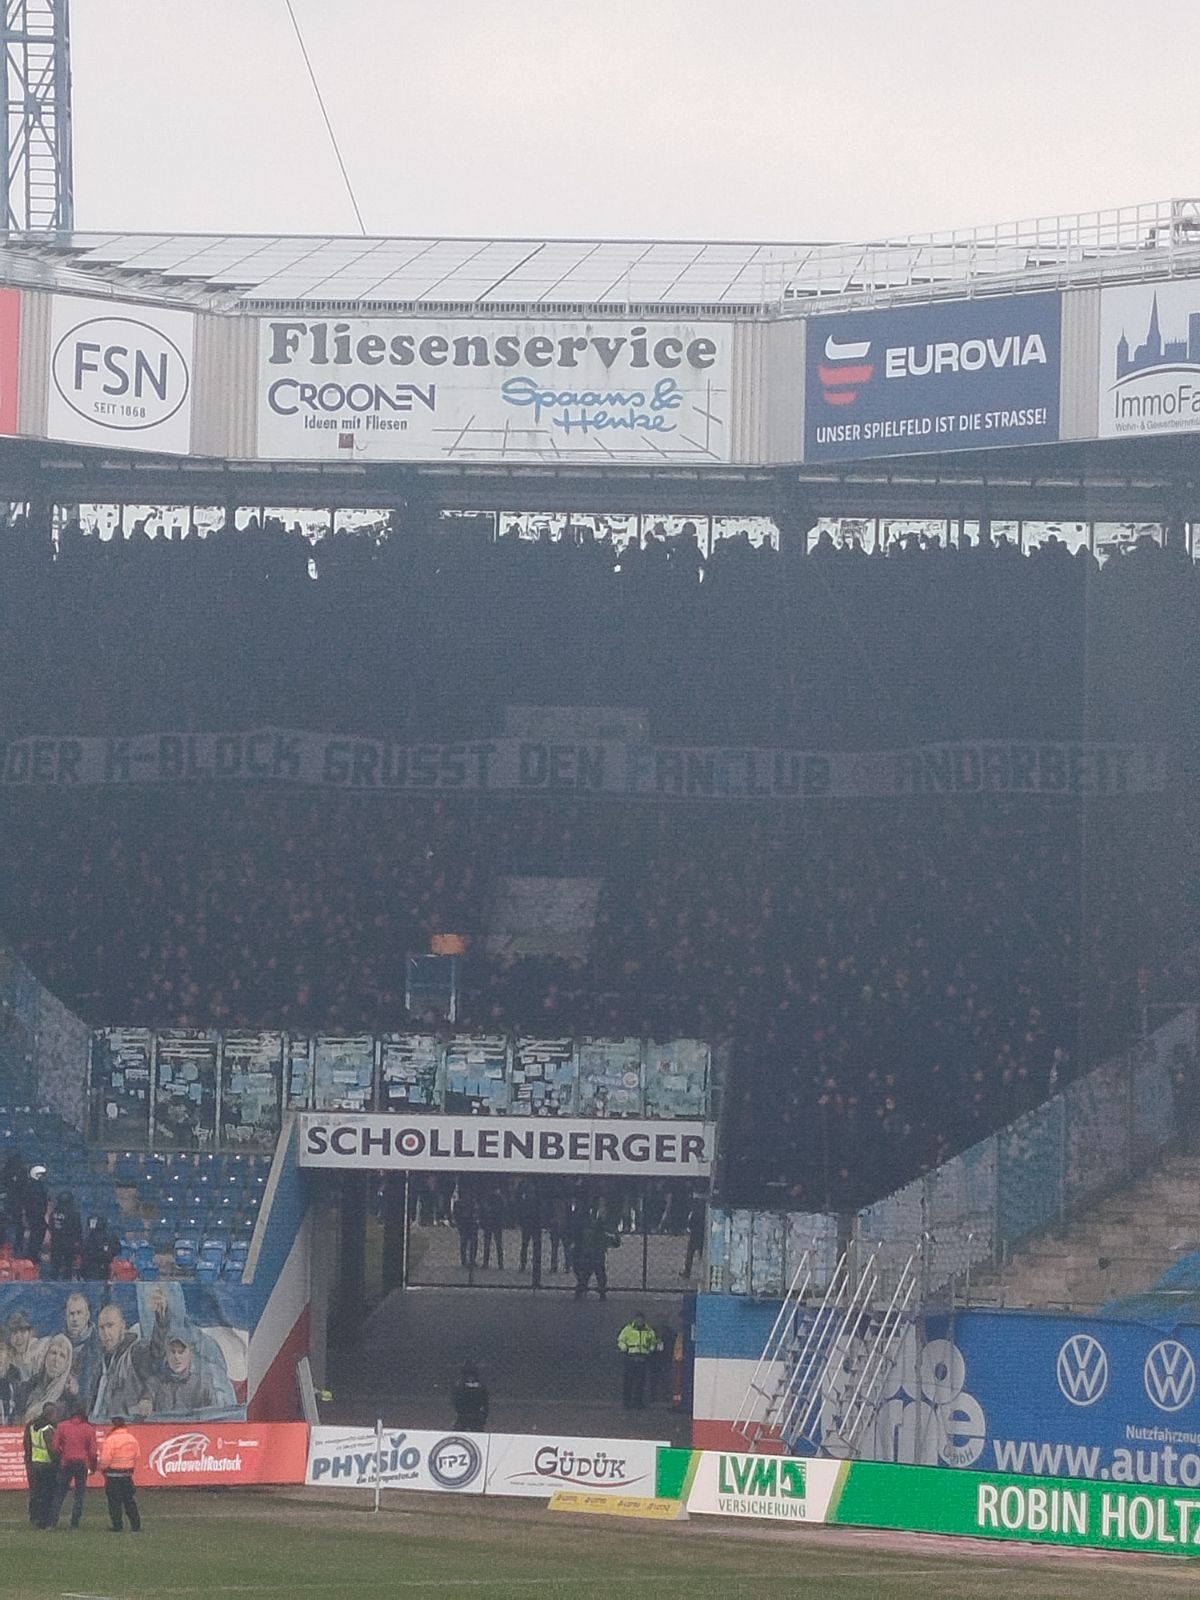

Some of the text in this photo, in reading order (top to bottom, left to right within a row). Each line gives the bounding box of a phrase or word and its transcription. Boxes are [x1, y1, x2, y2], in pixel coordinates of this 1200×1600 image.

[268, 322, 717, 369] Fliesenservice
[885, 334, 1047, 379] EUROVIA
[74, 342, 167, 401] FSN
[93, 402, 146, 418] SEIT 1868
[268, 378, 435, 415] CROONEN
[650, 377, 683, 411] &
[341, 416, 361, 430] mit
[366, 415, 408, 431] Fliesen
[553, 407, 677, 434] Henke
[816, 407, 1047, 443] UNSER SPIELFELD IST DIE STRASSE!
[519, 742, 605, 788] DEN
[307, 1127, 705, 1164] SCHOLLENBERGER
[1126, 1424, 1200, 1443] Nutzfahrzeu
[312, 1446, 420, 1480] PHYSIO
[534, 1446, 626, 1478] GÜDÜK
[718, 1455, 777, 1497] LVM
[719, 1499, 806, 1518] VERSICHERUNG
[977, 1484, 1087, 1534] ROBIN
